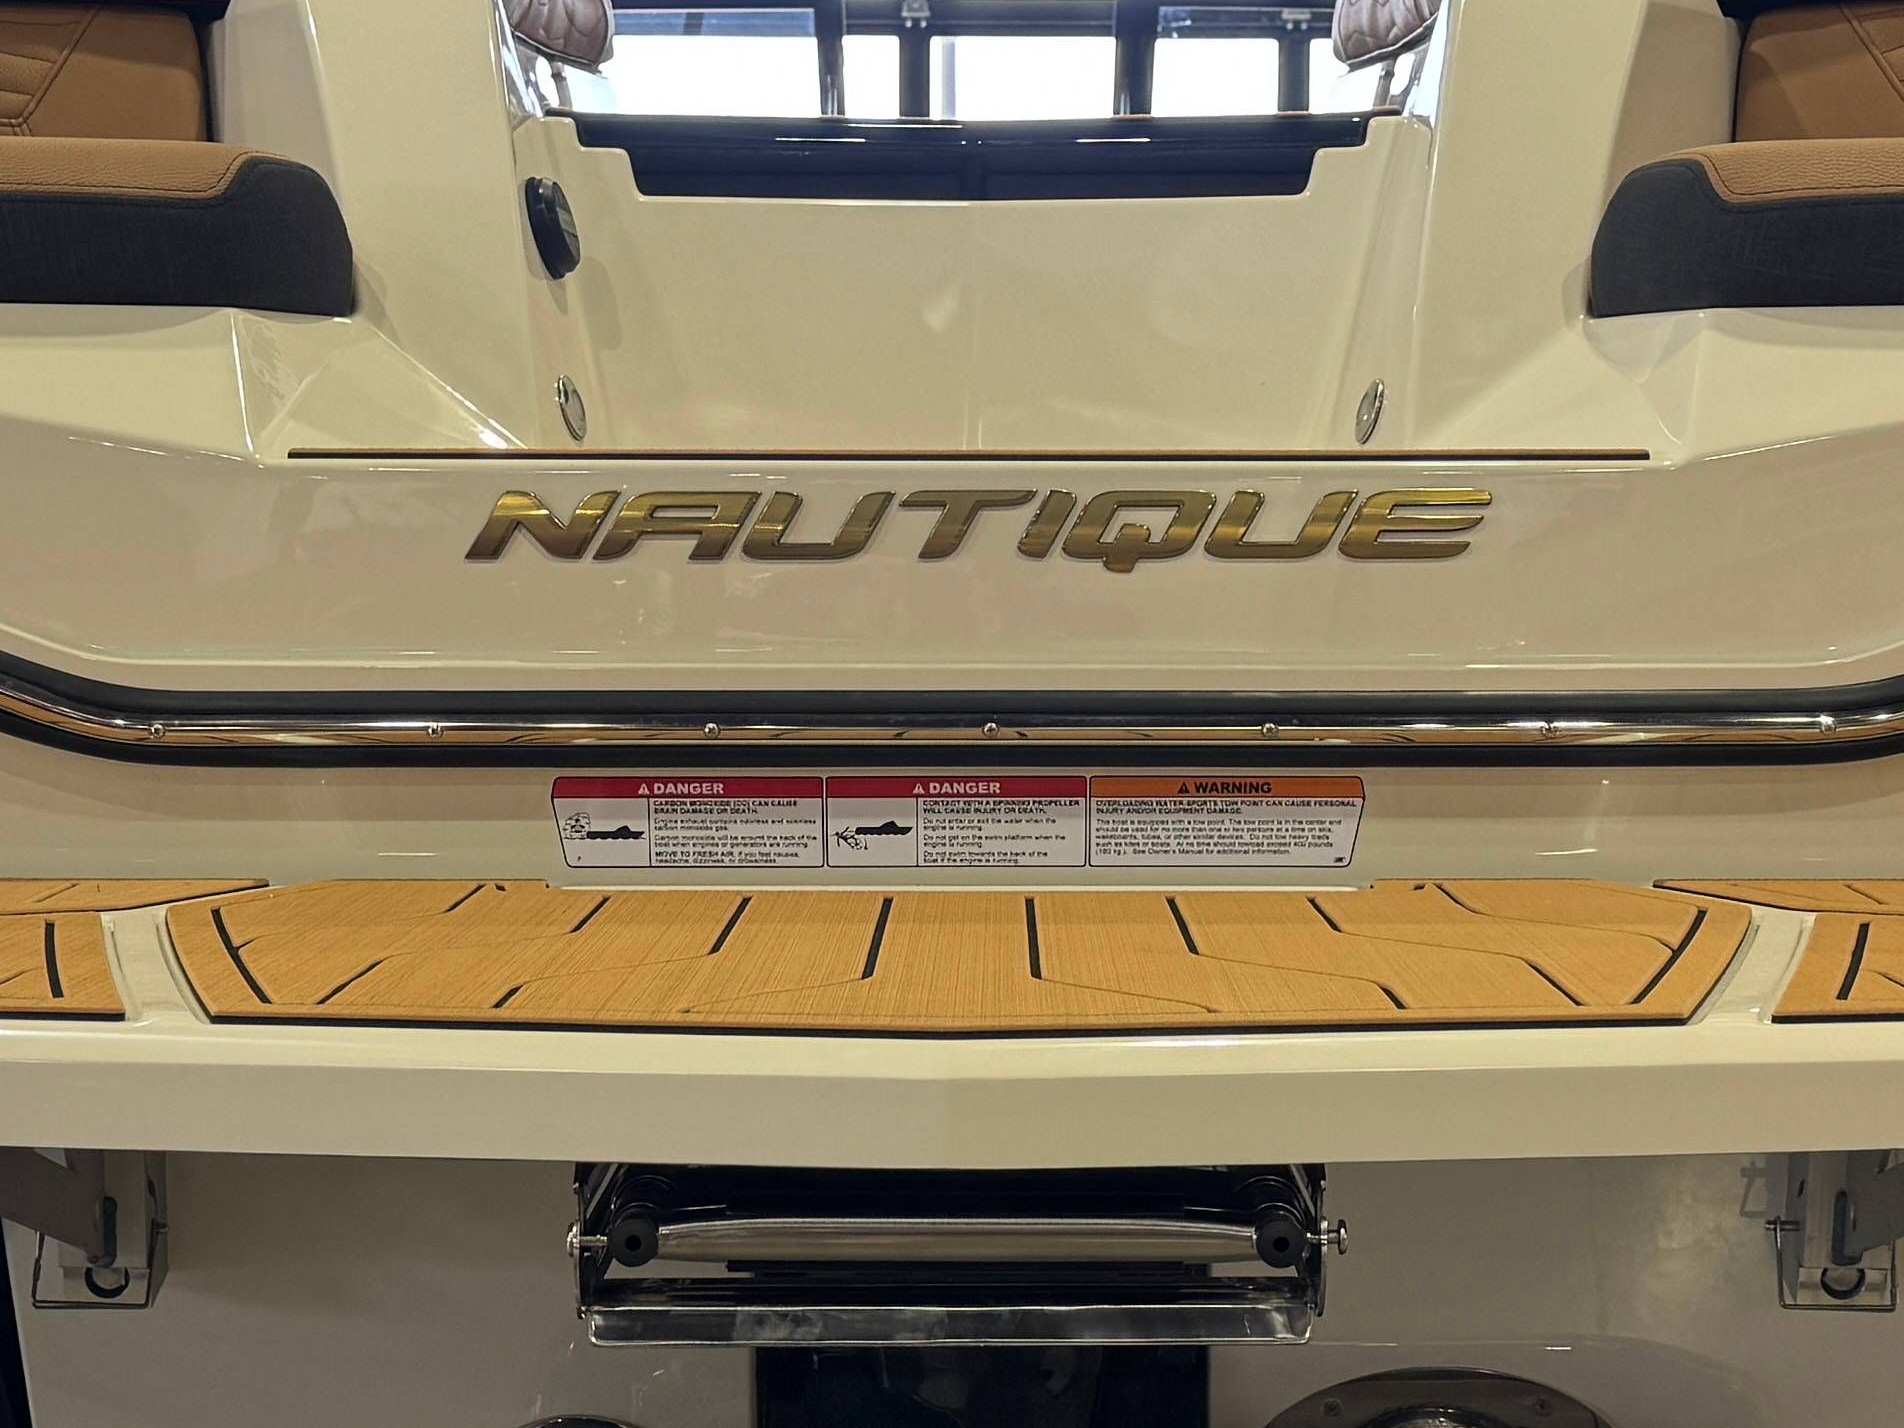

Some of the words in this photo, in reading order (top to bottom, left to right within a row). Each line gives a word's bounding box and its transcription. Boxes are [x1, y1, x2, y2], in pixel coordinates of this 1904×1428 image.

[466, 489, 1492, 572] NAUTIQUE
[654, 782, 724, 795] DANGER
[929, 782, 1001, 795] DANGER
[1194, 781, 1272, 794] WARNING
